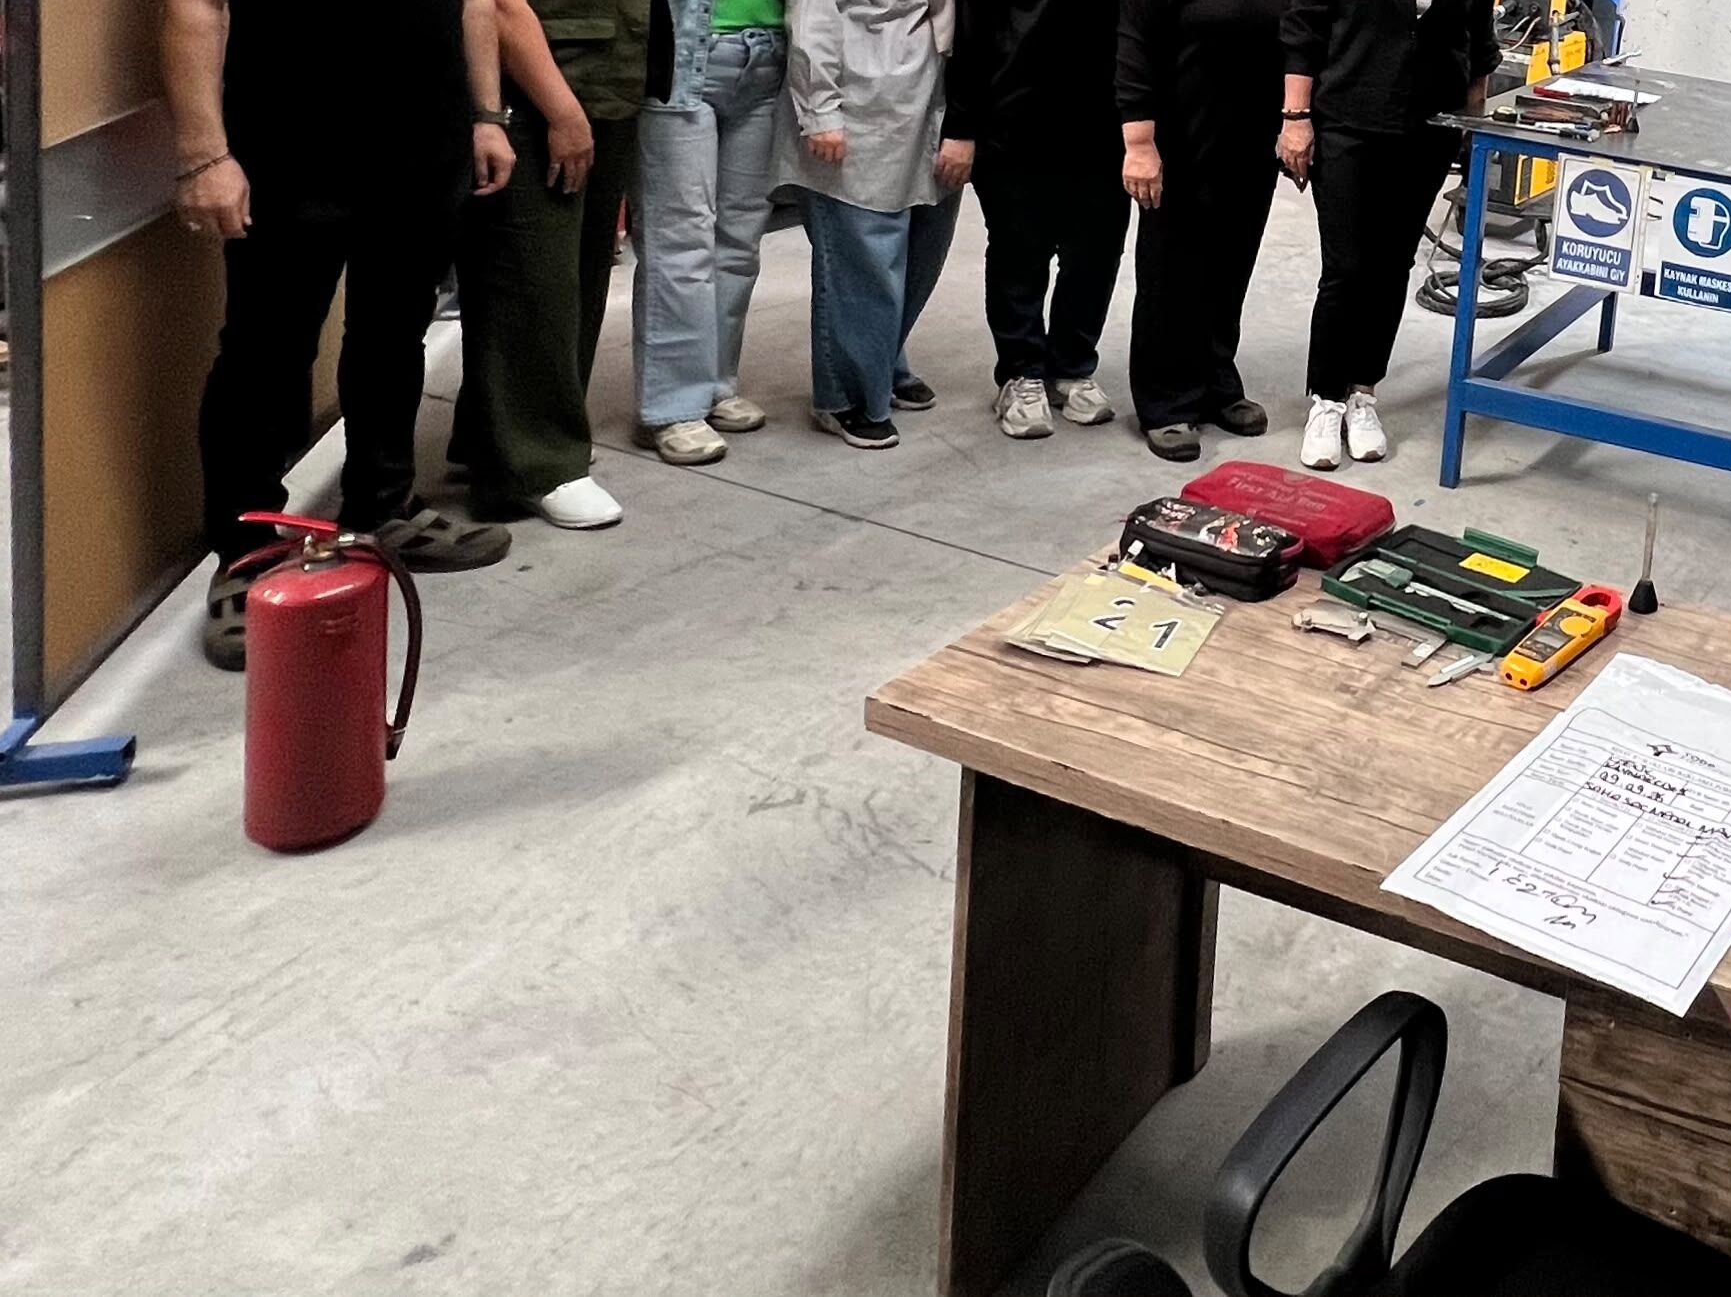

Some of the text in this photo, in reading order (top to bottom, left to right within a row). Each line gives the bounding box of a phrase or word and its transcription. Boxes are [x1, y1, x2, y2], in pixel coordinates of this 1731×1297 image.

[1561, 240, 1622, 265] KORUYUCU
[1556, 257, 1609, 279] AYAKKABINI
[1663, 268, 1698, 285] KAYNAK
[1676, 285, 1719, 304] KULLANIN
[1152, 620, 1179, 649] 1
